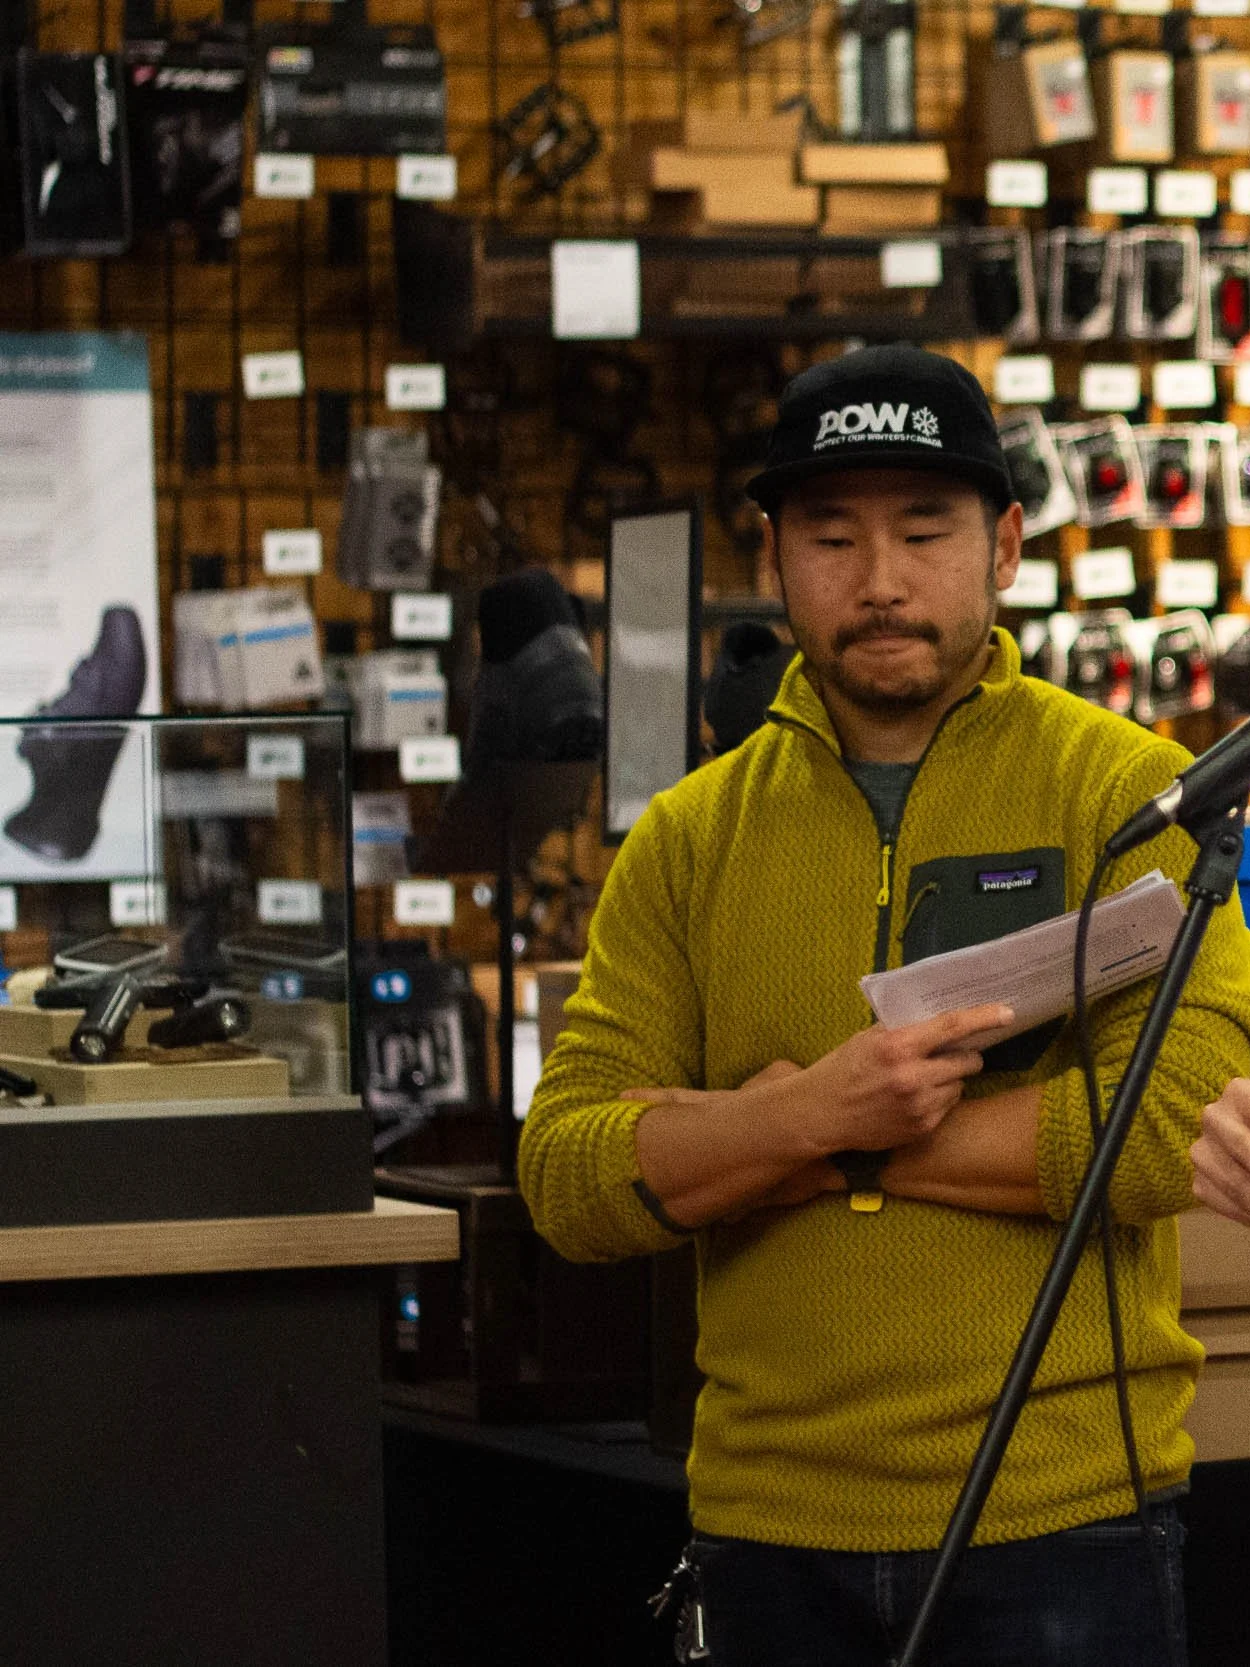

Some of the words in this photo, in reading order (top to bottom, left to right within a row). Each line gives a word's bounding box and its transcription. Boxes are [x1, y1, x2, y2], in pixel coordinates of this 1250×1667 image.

[815, 402, 910, 441] POW
[848, 433, 866, 442] OUR
[983, 878, 1033, 891] patagonia
